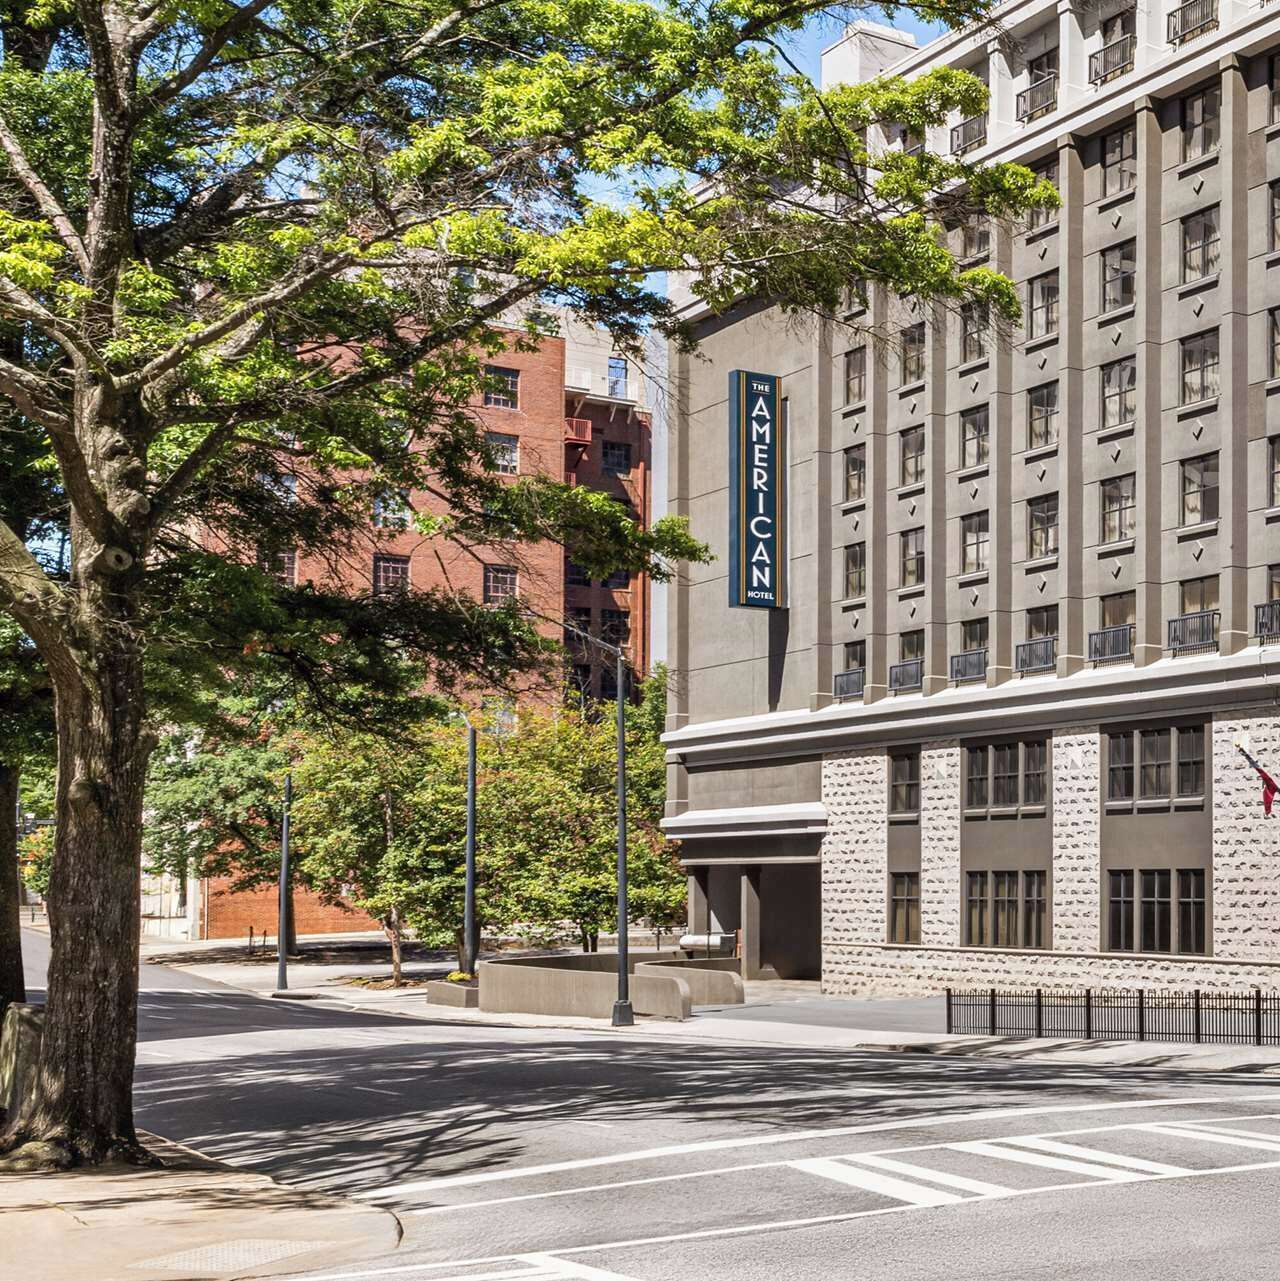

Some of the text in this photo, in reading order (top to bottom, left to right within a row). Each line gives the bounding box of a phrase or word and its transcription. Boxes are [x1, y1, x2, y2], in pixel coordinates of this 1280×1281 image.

[752, 383, 770, 393] THE
[751, 396, 771, 588] AMERICAN
[747, 590, 775, 600] HOTEL
